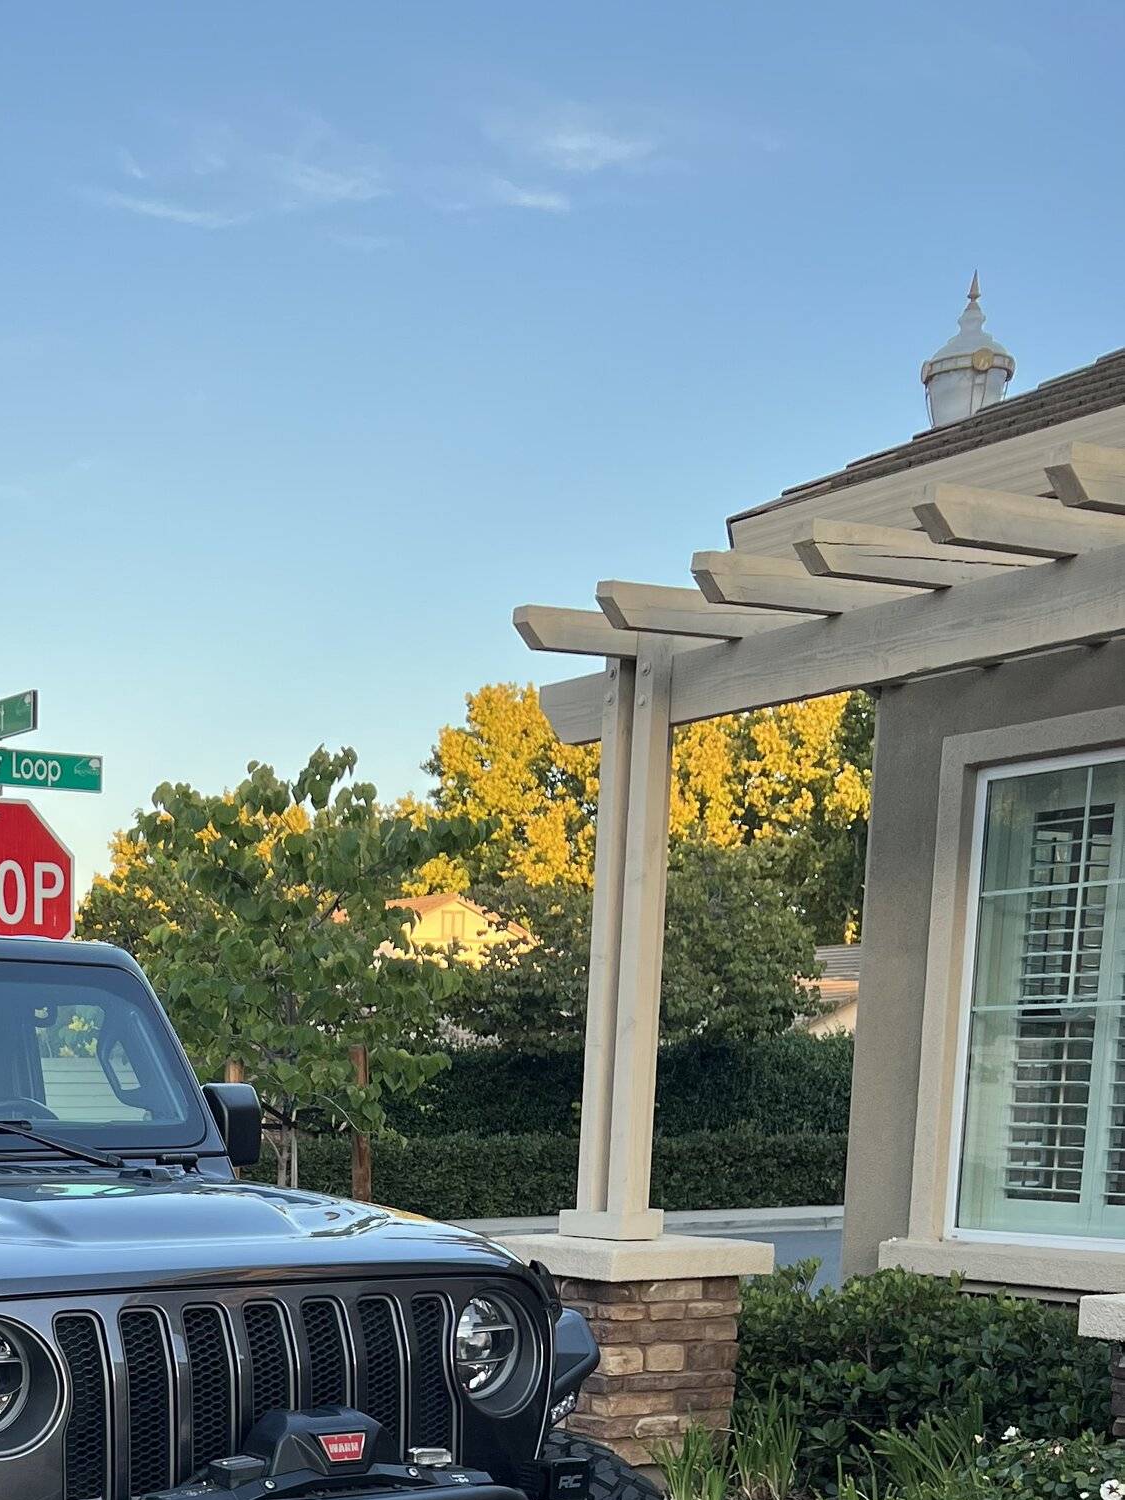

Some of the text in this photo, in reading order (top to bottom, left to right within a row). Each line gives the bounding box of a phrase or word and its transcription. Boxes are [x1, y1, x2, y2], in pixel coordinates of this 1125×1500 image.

[12, 752, 62, 786] Loop
[328, 1442, 360, 1454] WARN
[557, 1474, 583, 1489] RC
